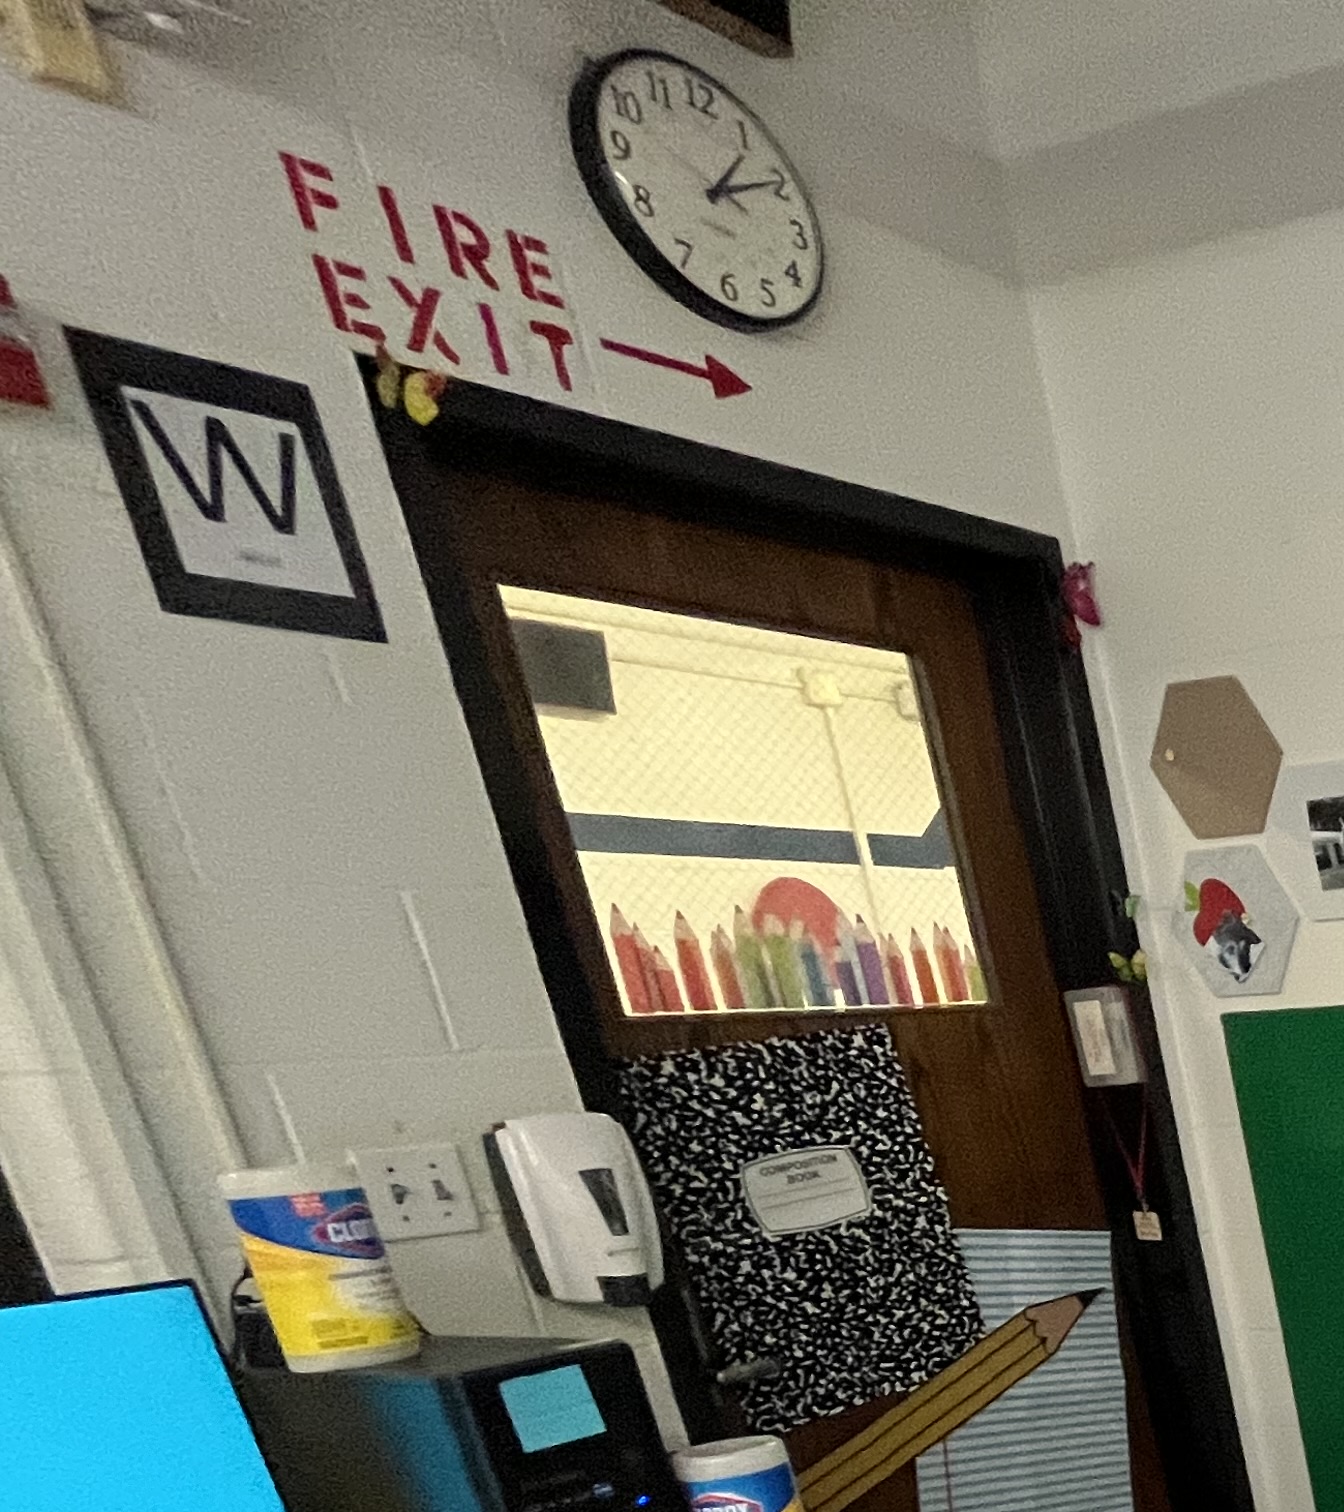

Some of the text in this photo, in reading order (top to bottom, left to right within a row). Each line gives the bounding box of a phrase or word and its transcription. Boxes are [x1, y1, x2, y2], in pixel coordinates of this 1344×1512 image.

[610, 84, 642, 125] 10
[646, 70, 673, 111] 11
[684, 76, 719, 120] 12
[610, 130, 632, 161] 9
[737, 119, 752, 151] 1
[632, 184, 655, 218] 8
[769, 167, 791, 202] 2
[278, 150, 565, 310] FIRE
[788, 217, 809, 251] 3
[674, 237, 694, 270] 7
[720, 272, 739, 302] 6
[784, 260, 804, 289] 4
[760, 277, 777, 308] 5
[312, 253, 574, 392] EXIT
[130, 399, 296, 536] W
[759, 1153, 838, 1177] COMPOSITION
[787, 1170, 820, 1185] BOOK
